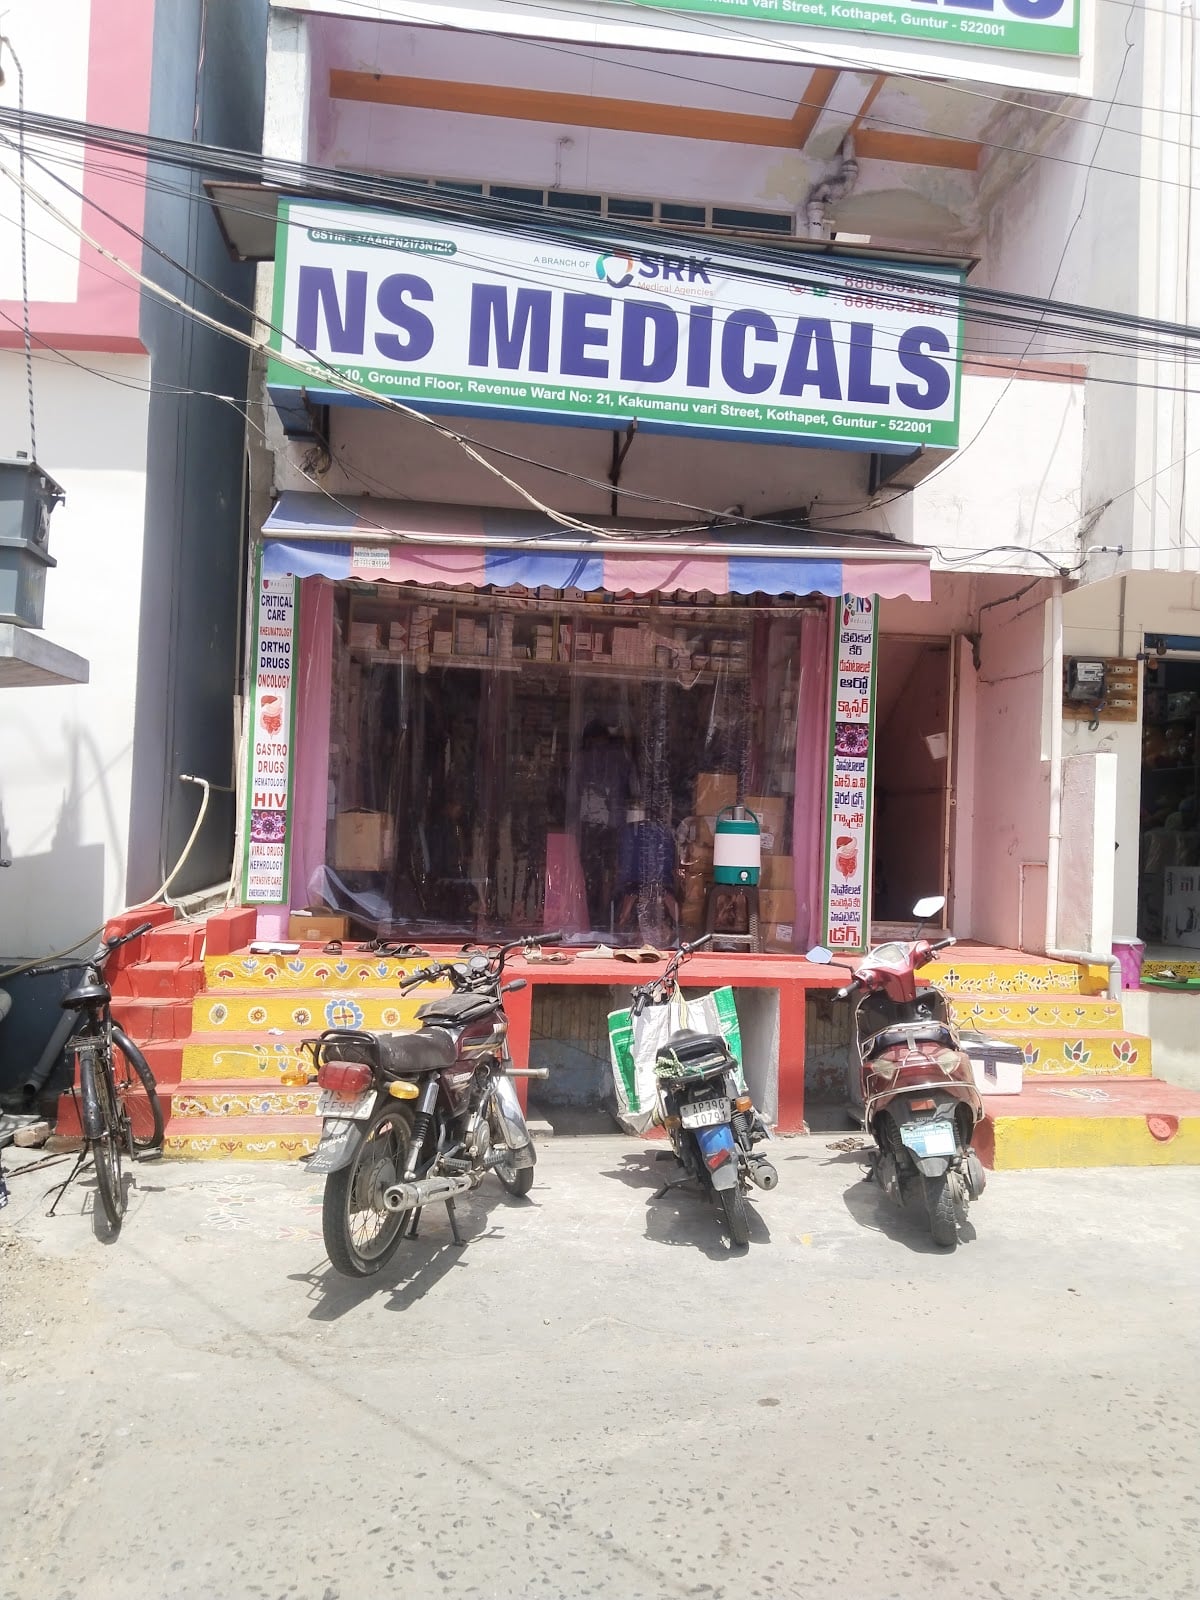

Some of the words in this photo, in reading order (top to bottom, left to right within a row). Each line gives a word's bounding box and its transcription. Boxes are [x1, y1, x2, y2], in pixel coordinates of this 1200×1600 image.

[782, 0, 827, 17] Street,
[831, 5, 897, 25] Kothapet,
[901, 13, 948, 29] Guntur
[960, 20, 1006, 37] 522001
[533, 256, 541, 264] A
[541, 257, 576, 268] BRANCH
[579, 259, 591, 269] OF
[638, 251, 713, 285] SRK
[637, 281, 672, 295] Medical
[673, 286, 714, 299] Agencies
[295, 265, 434, 362] NS
[467, 282, 951, 411] MEDICALS
[368, 371, 421, 388] Ground
[424, 377, 464, 393] Floor,
[467, 381, 527, 398] Revenue
[530, 386, 567, 403] Ward
[569, 390, 593, 404] No:
[596, 393, 617, 408] 21,
[618, 394, 689, 412] Kakumanu
[692, 401, 718, 415] vari
[720, 402, 763, 421] Street,
[766, 409, 829, 427] Kothapet,
[832, 414, 878, 430] Guntur
[888, 419, 932, 434] 522001
[261, 595, 293, 608] CRITICAL
[267, 609, 286, 621] CARE
[260, 626, 292, 637] RHEUMATOLOGY
[261, 641, 291, 654] ORTHO
[260, 656, 290, 669] DRUGS
[258, 674, 291, 688] ONCOLOGY
[256, 742, 288, 757] GASTRO
[257, 760, 285, 774] DRUGS
[254, 777, 287, 788] HEMATOLOGY
[254, 793, 287, 808] HIV
[251, 846, 266, 856] VIRAL
[266, 846, 284, 857] DRUGS
[250, 860, 283, 871] NEPHROLOGY
[249, 876, 271, 885] INTENSIVE
[271, 876, 282, 886] CARE
[248, 888, 269, 898] EMERGENCY
[269, 889, 281, 898] DRUGS
